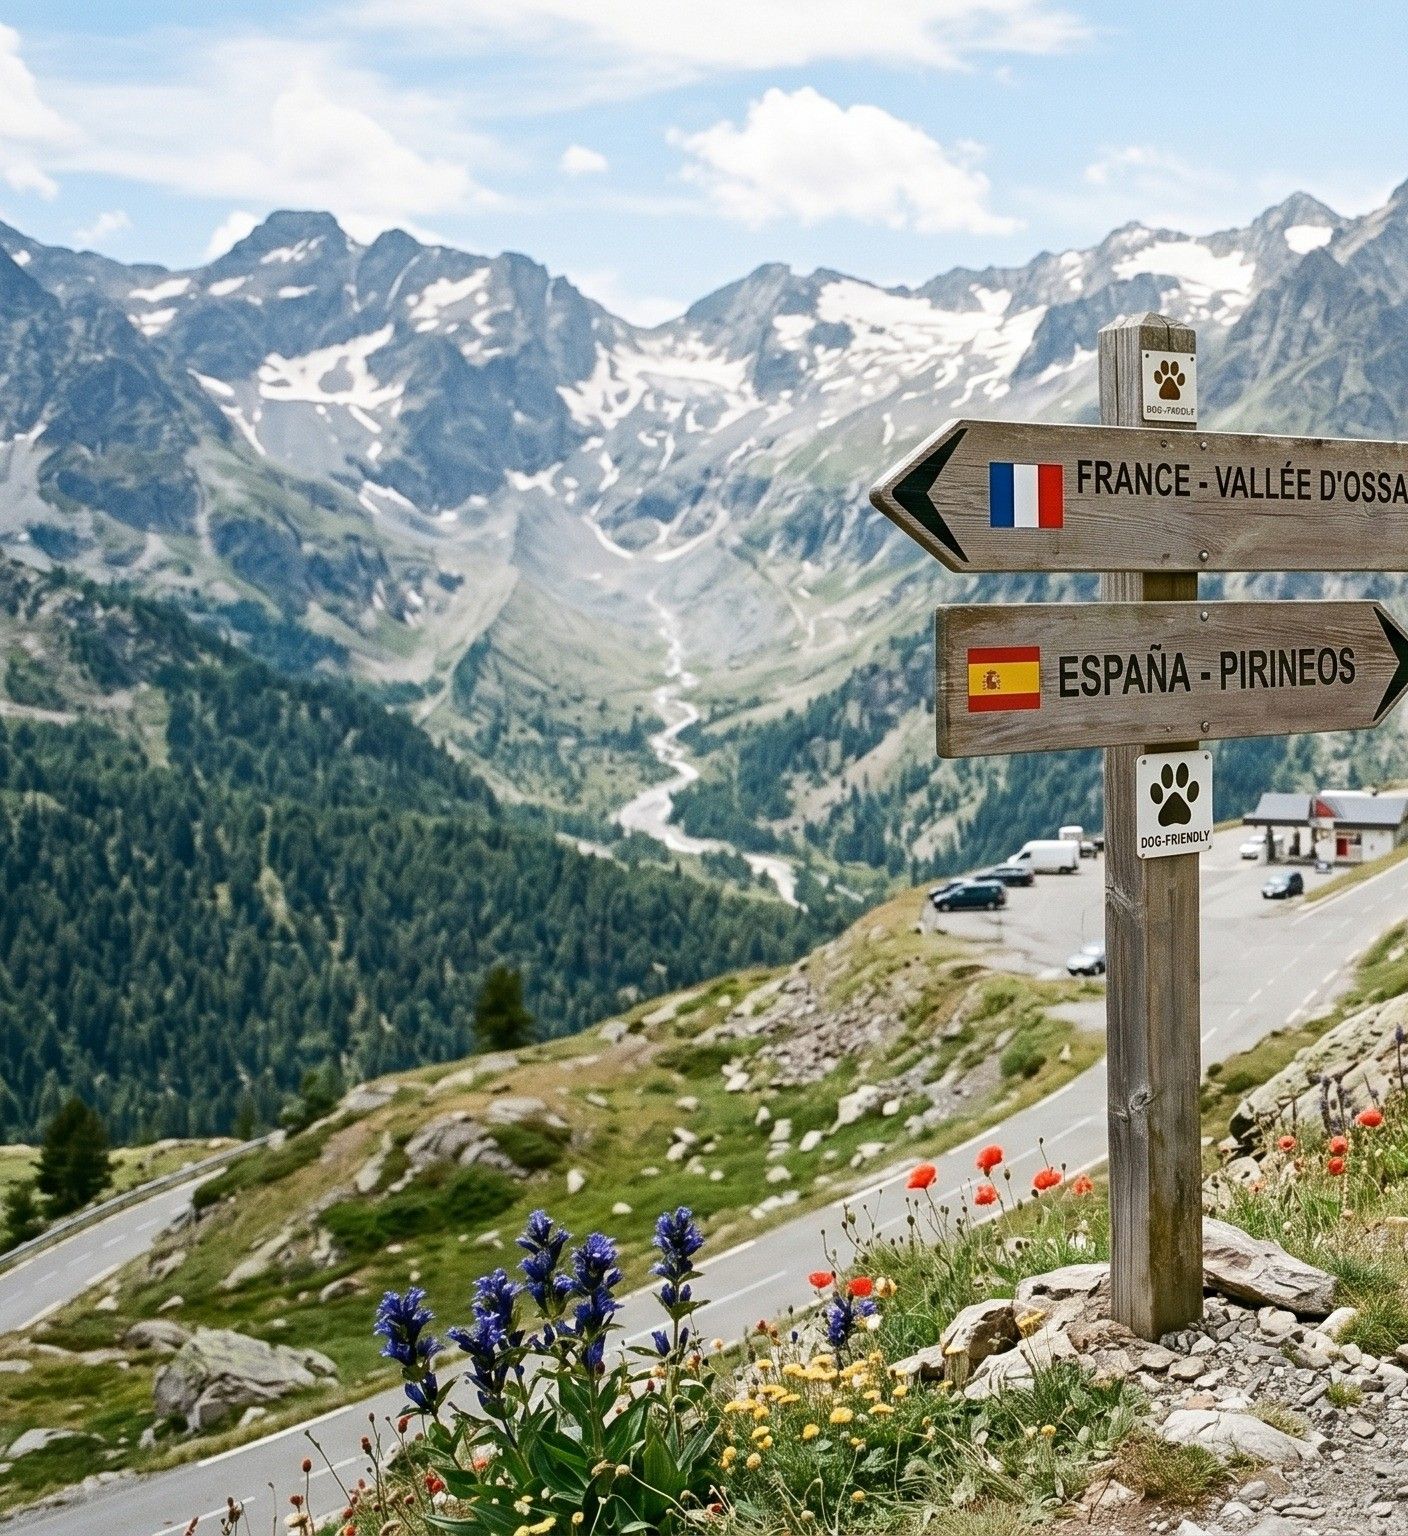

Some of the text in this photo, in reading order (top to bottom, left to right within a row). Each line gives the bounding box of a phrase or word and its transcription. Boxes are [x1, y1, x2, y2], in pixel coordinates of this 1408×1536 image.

[1077, 459, 1191, 497] FRANCE
[1215, 460, 1312, 500] VALLÉE
[1059, 643, 1191, 697] ESPAÑA
[1220, 647, 1356, 690] PIRINEOS
[1141, 830, 1210, 848] DOG-FRIENDLY
